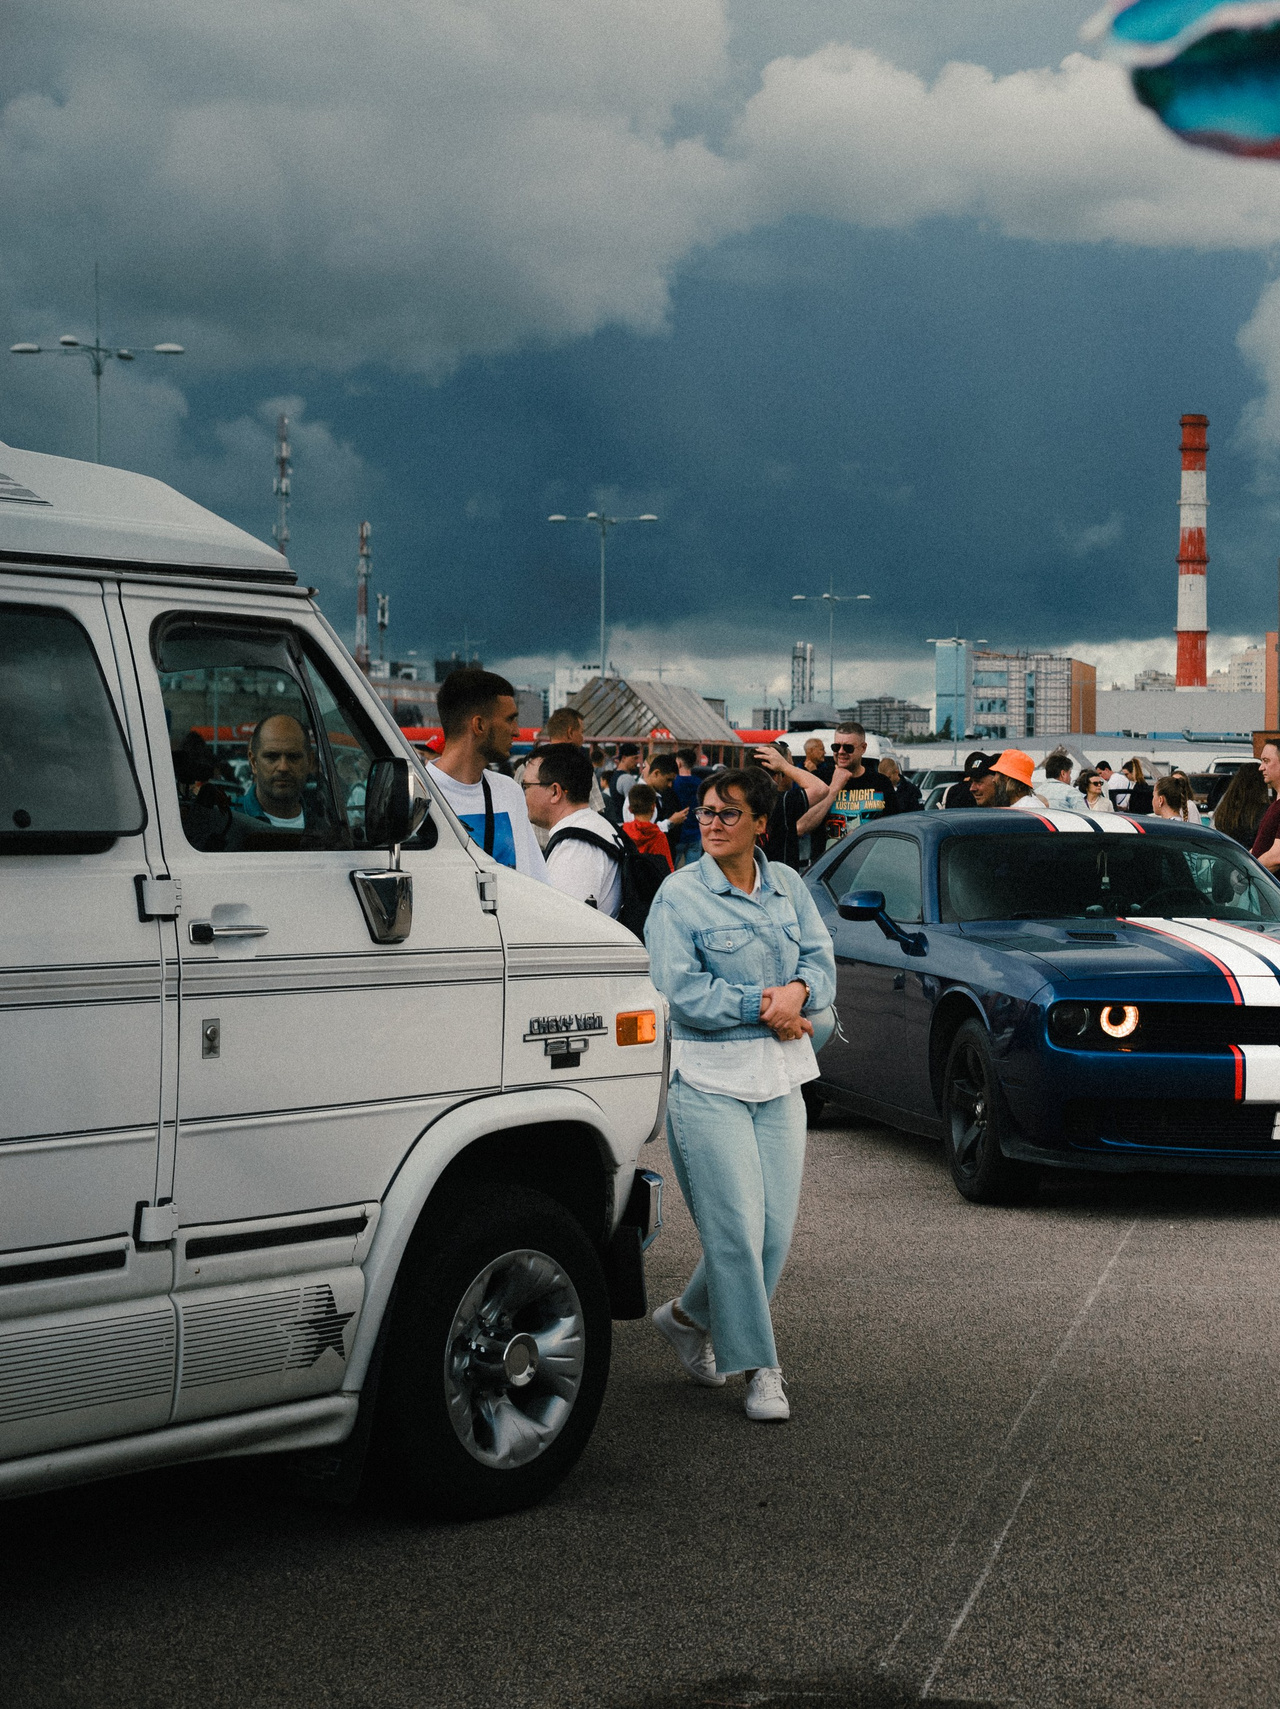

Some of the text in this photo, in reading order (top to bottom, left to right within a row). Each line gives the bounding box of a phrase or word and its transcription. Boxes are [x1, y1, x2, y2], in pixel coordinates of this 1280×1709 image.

[849, 788, 875, 802] NIGHT
[835, 801, 860, 810] KUSTOM
[529, 1014, 574, 1035] CHEVY
[544, 1036, 589, 1056] 20
